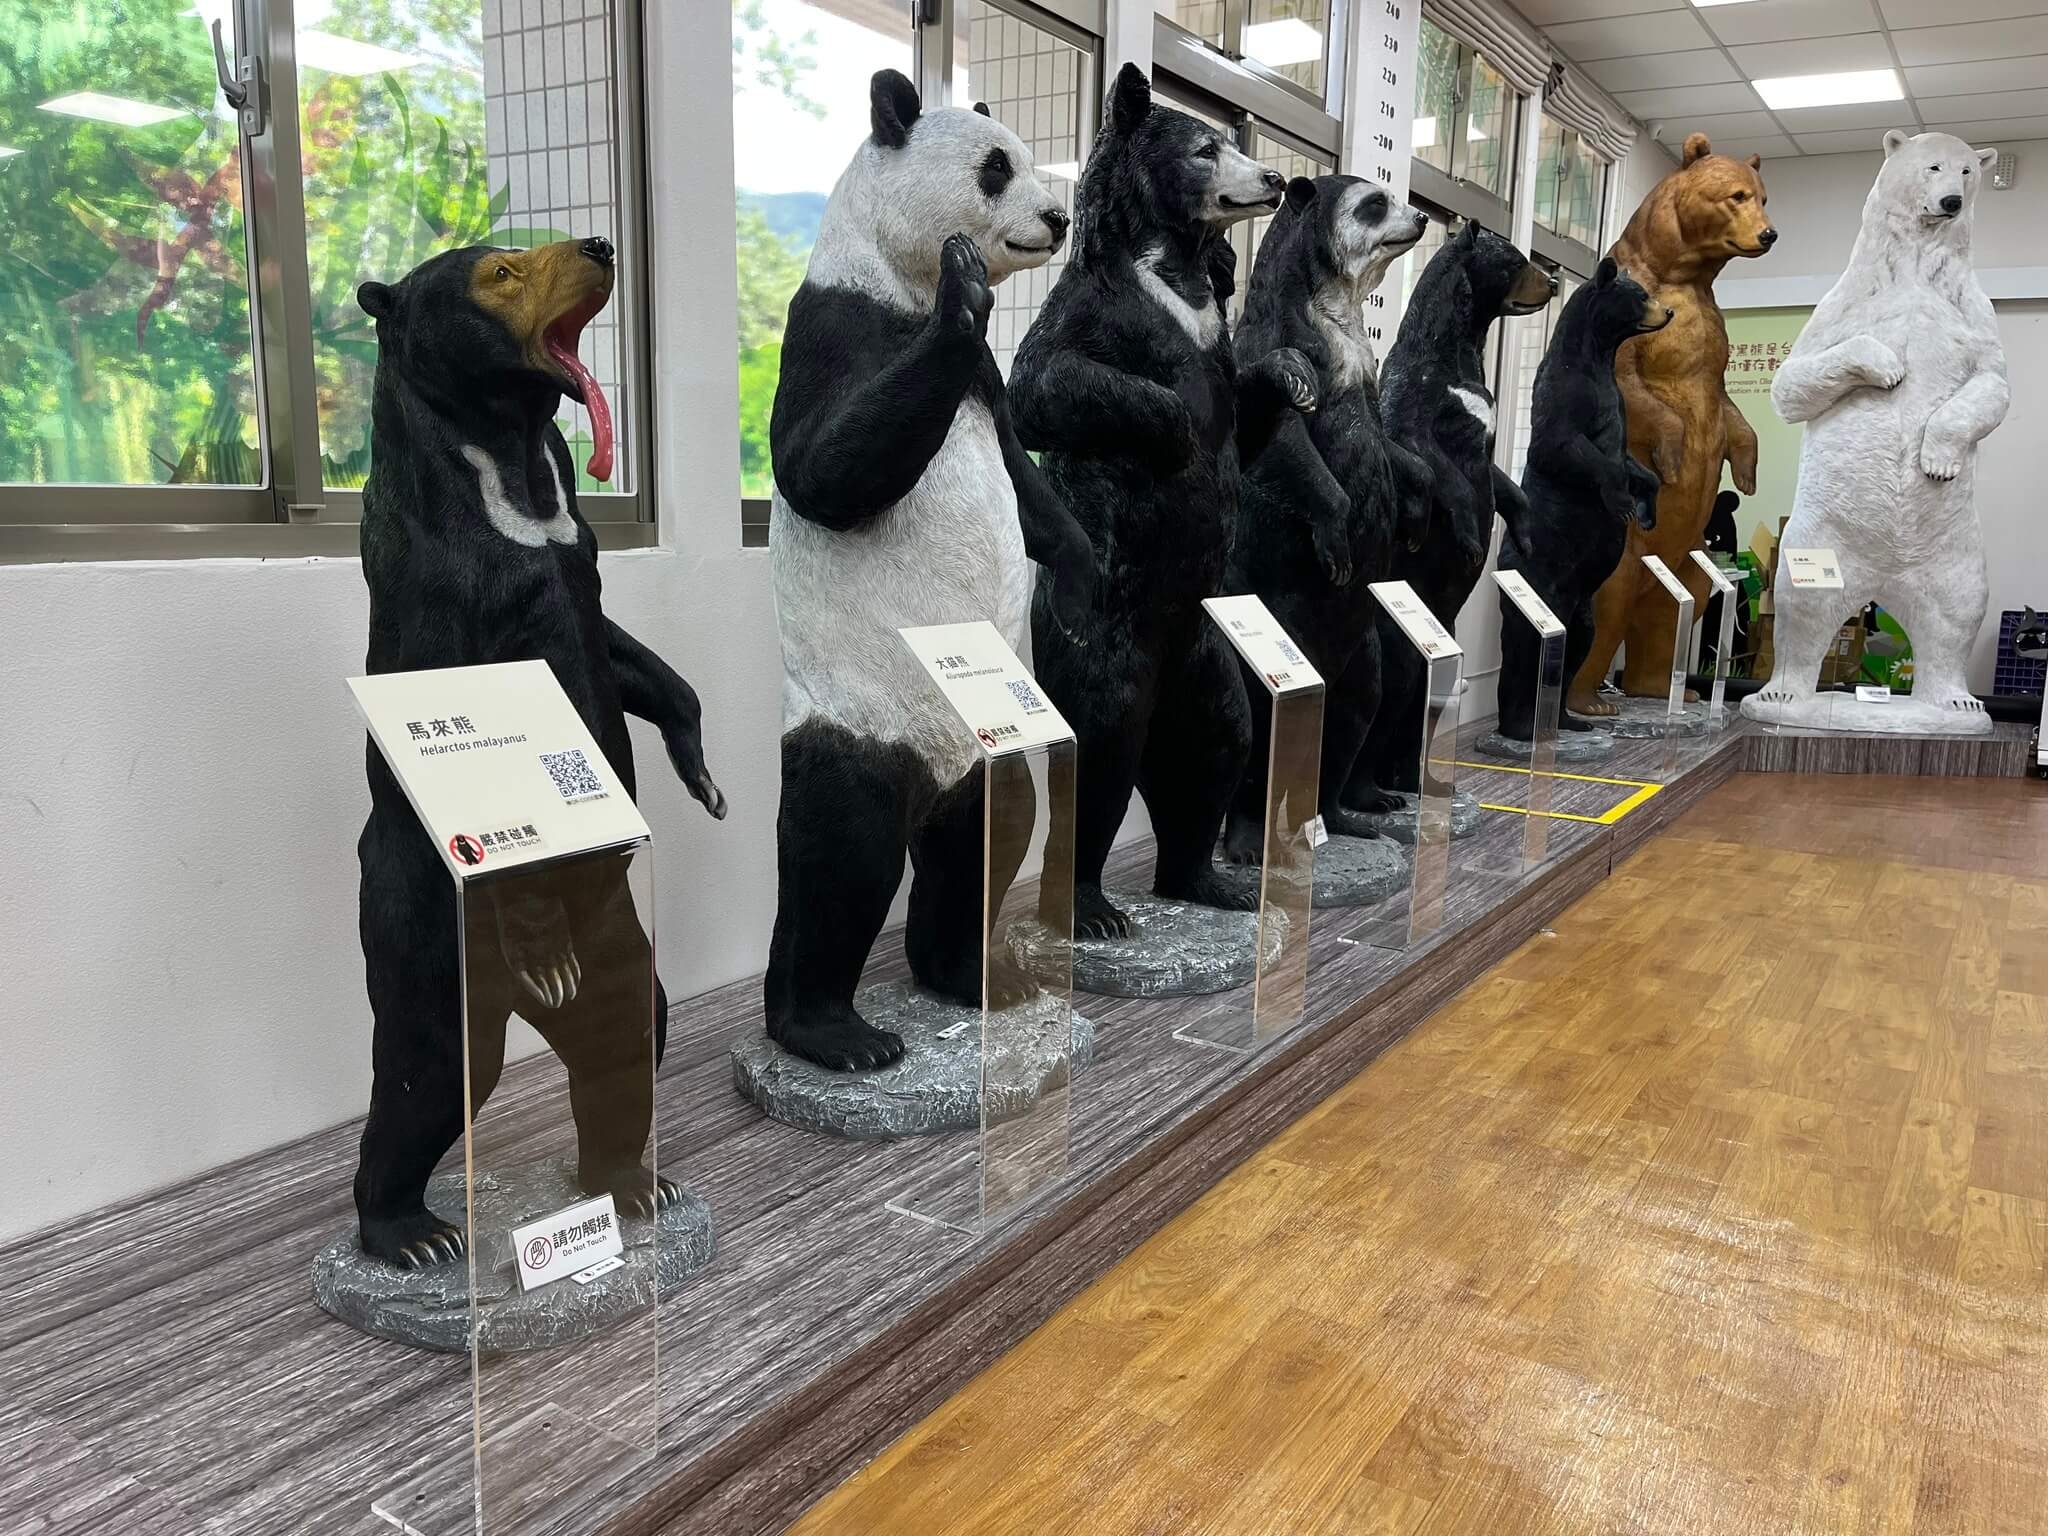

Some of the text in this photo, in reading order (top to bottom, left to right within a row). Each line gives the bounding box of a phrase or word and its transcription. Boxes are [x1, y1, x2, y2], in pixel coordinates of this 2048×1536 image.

[1386, 1, 1400, 20] 240
[1384, 34, 1398, 53] 230
[1383, 67, 1396, 86] 220
[1381, 101, 1394, 119] 210
[1377, 166, 1391, 183] 190
[1368, 326, 1382, 340] 140
[406, 715, 476, 741] 馬來熊
[420, 734, 527, 757] Helarctos malayanus
[479, 824, 539, 847] 嚴禁碰觸
[487, 838, 542, 855] DO NOT TOUCH
[552, 1213, 612, 1249] 請勿觸摸
[562, 1235, 607, 1257] Do Not Touch
